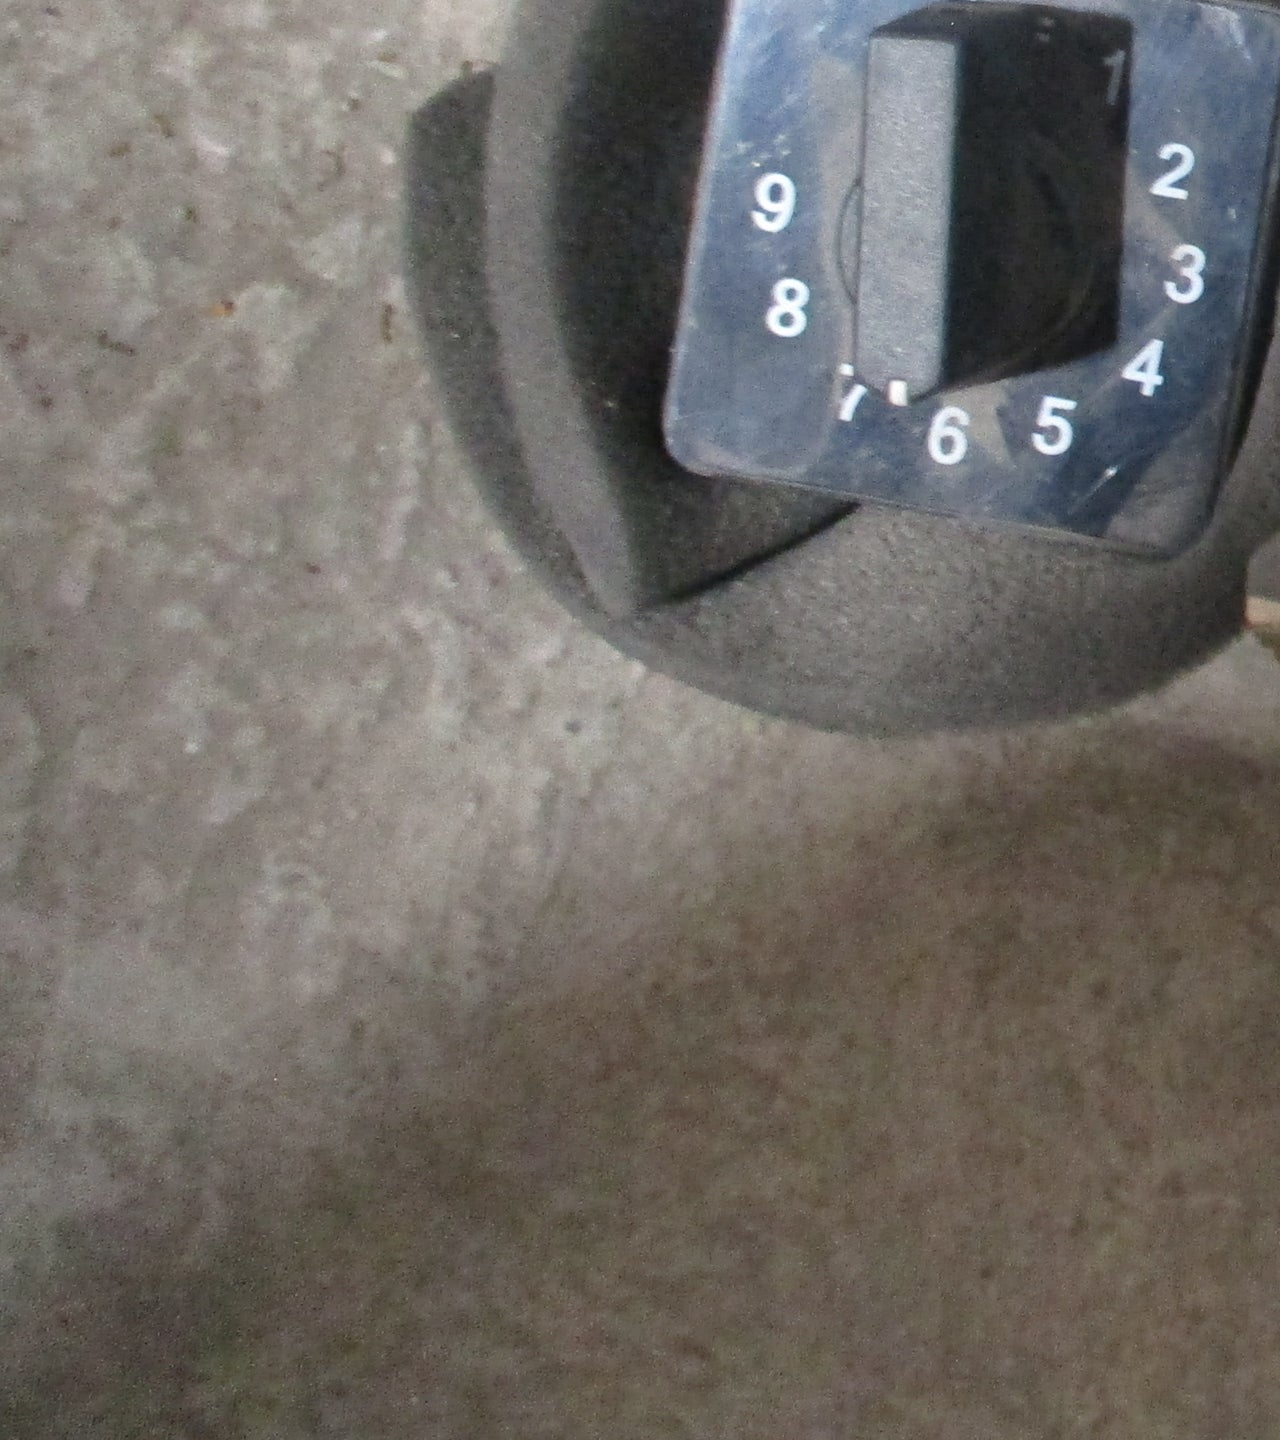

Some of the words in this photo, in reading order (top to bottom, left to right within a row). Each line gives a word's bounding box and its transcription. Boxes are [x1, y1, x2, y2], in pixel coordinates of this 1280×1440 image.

[1149, 142, 1196, 201] 2
[750, 171, 797, 233] 9
[1163, 244, 1207, 304] 3
[764, 277, 811, 338] 8
[1121, 338, 1165, 398] 4
[927, 406, 972, 465] 6
[1031, 396, 1077, 456] 5
